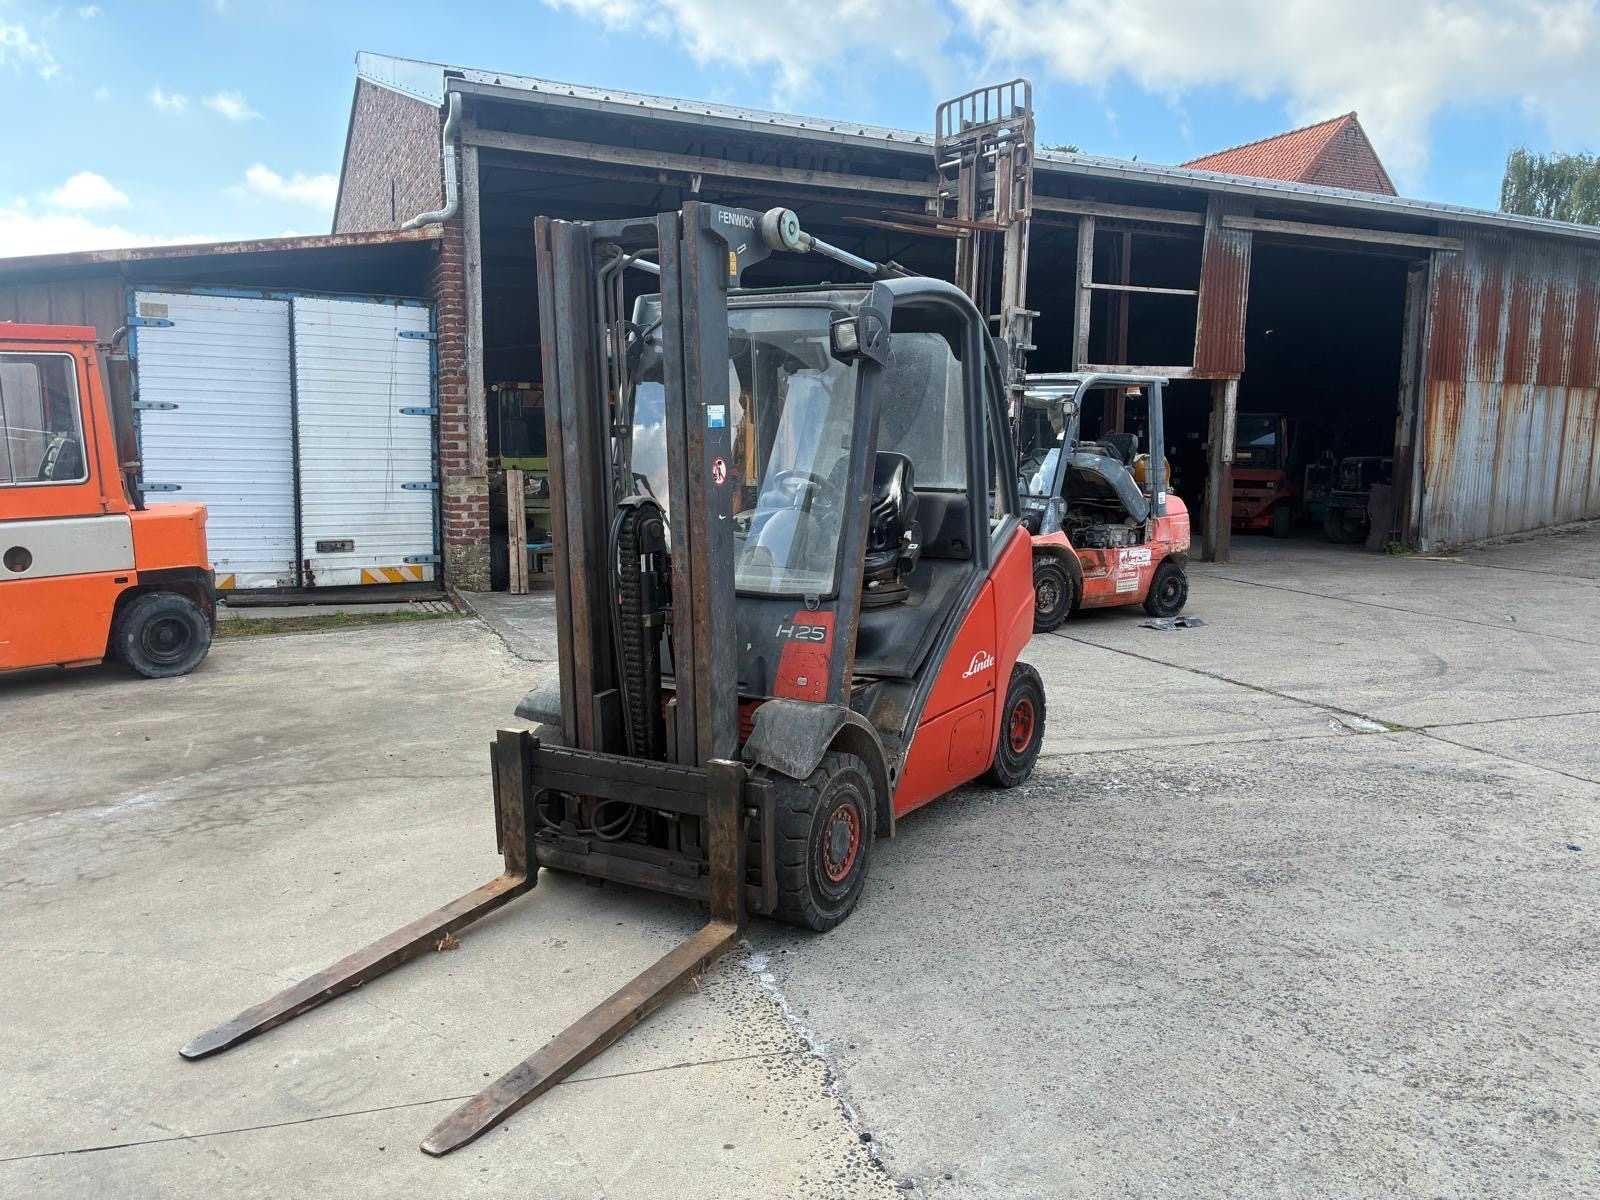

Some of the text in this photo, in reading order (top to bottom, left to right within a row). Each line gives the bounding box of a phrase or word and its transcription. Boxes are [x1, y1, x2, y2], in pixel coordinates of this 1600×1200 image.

[718, 210, 755, 230] FENWICK
[775, 624, 825, 641] H25
[962, 650, 995, 678] Linde
